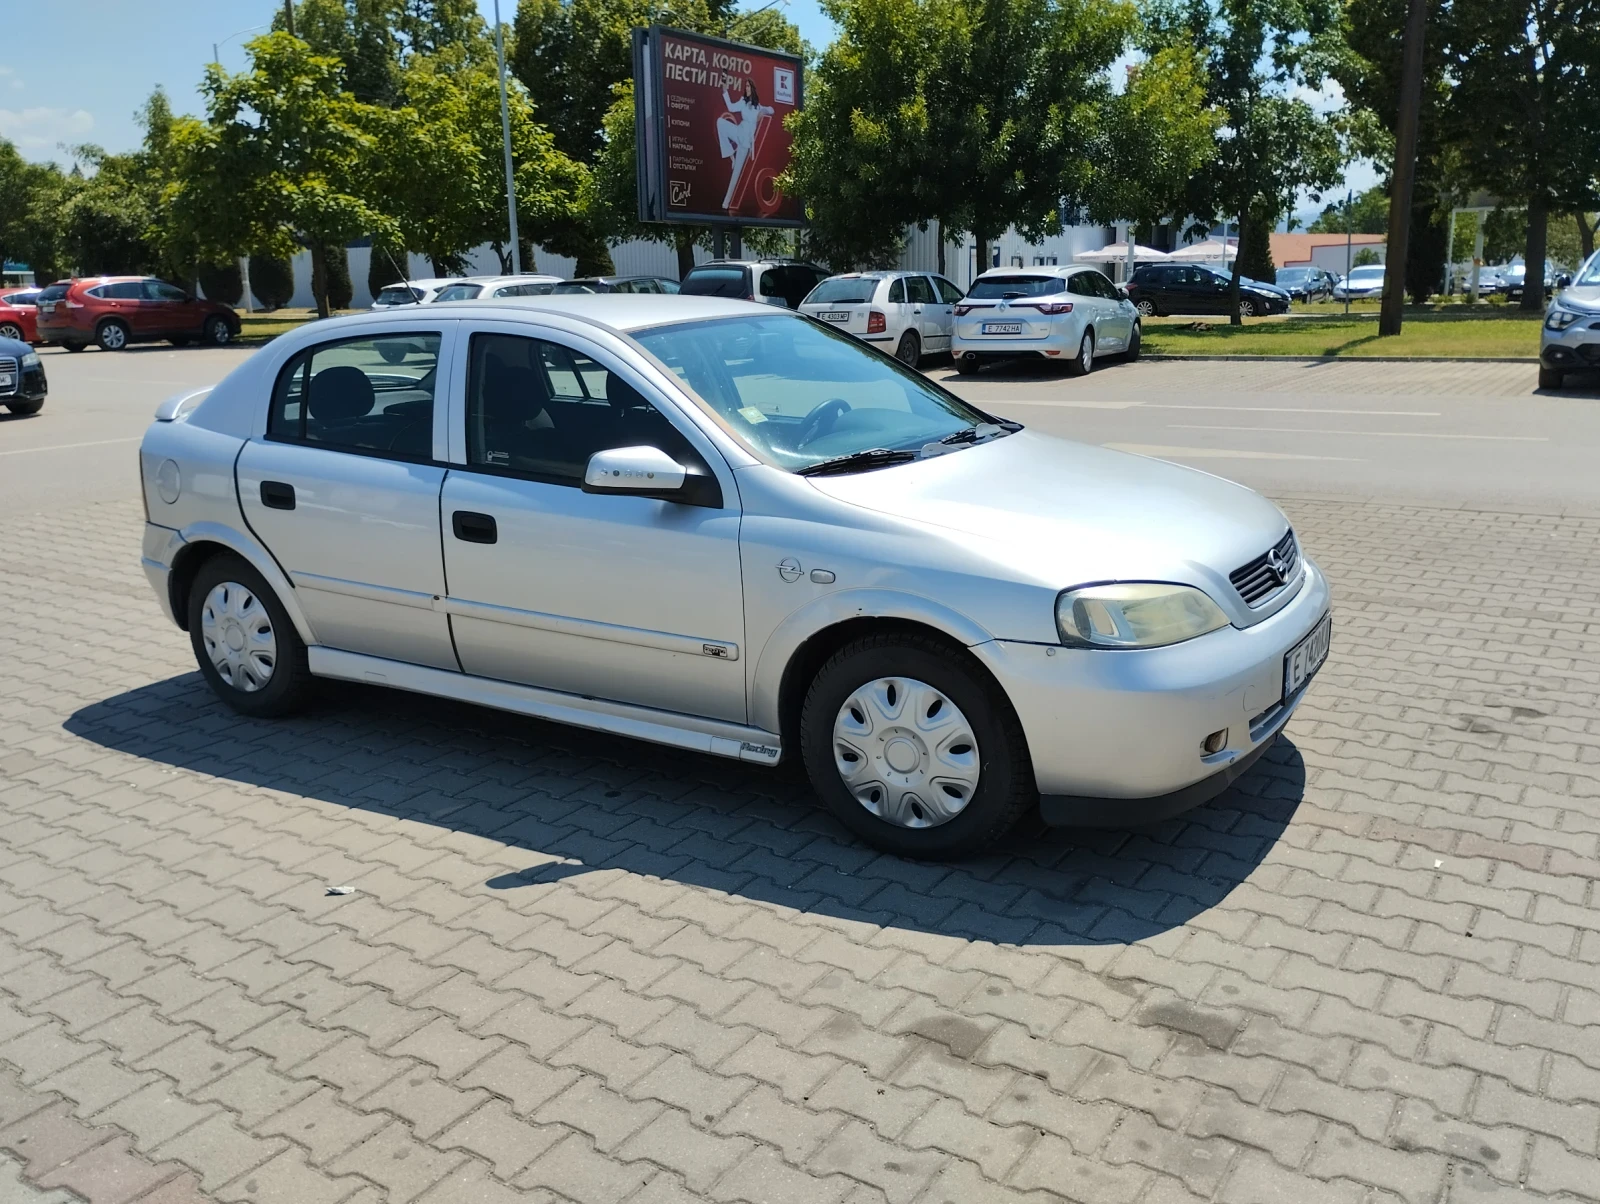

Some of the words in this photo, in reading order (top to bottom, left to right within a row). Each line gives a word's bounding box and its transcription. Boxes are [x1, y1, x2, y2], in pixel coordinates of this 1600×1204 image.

[665, 42, 709, 69] КАРТА,
[712, 52, 752, 75] КОЯТО
[666, 63, 706, 85] ПЕСТИ
[671, 102, 690, 110] ОФЕРТИ
[671, 119, 690, 127] КУПОНИ
[672, 143, 694, 151] НАГРАДИ
[672, 182, 691, 203] Card
[1293, 651, 1301, 684] E
[740, 741, 778, 758] Racing
